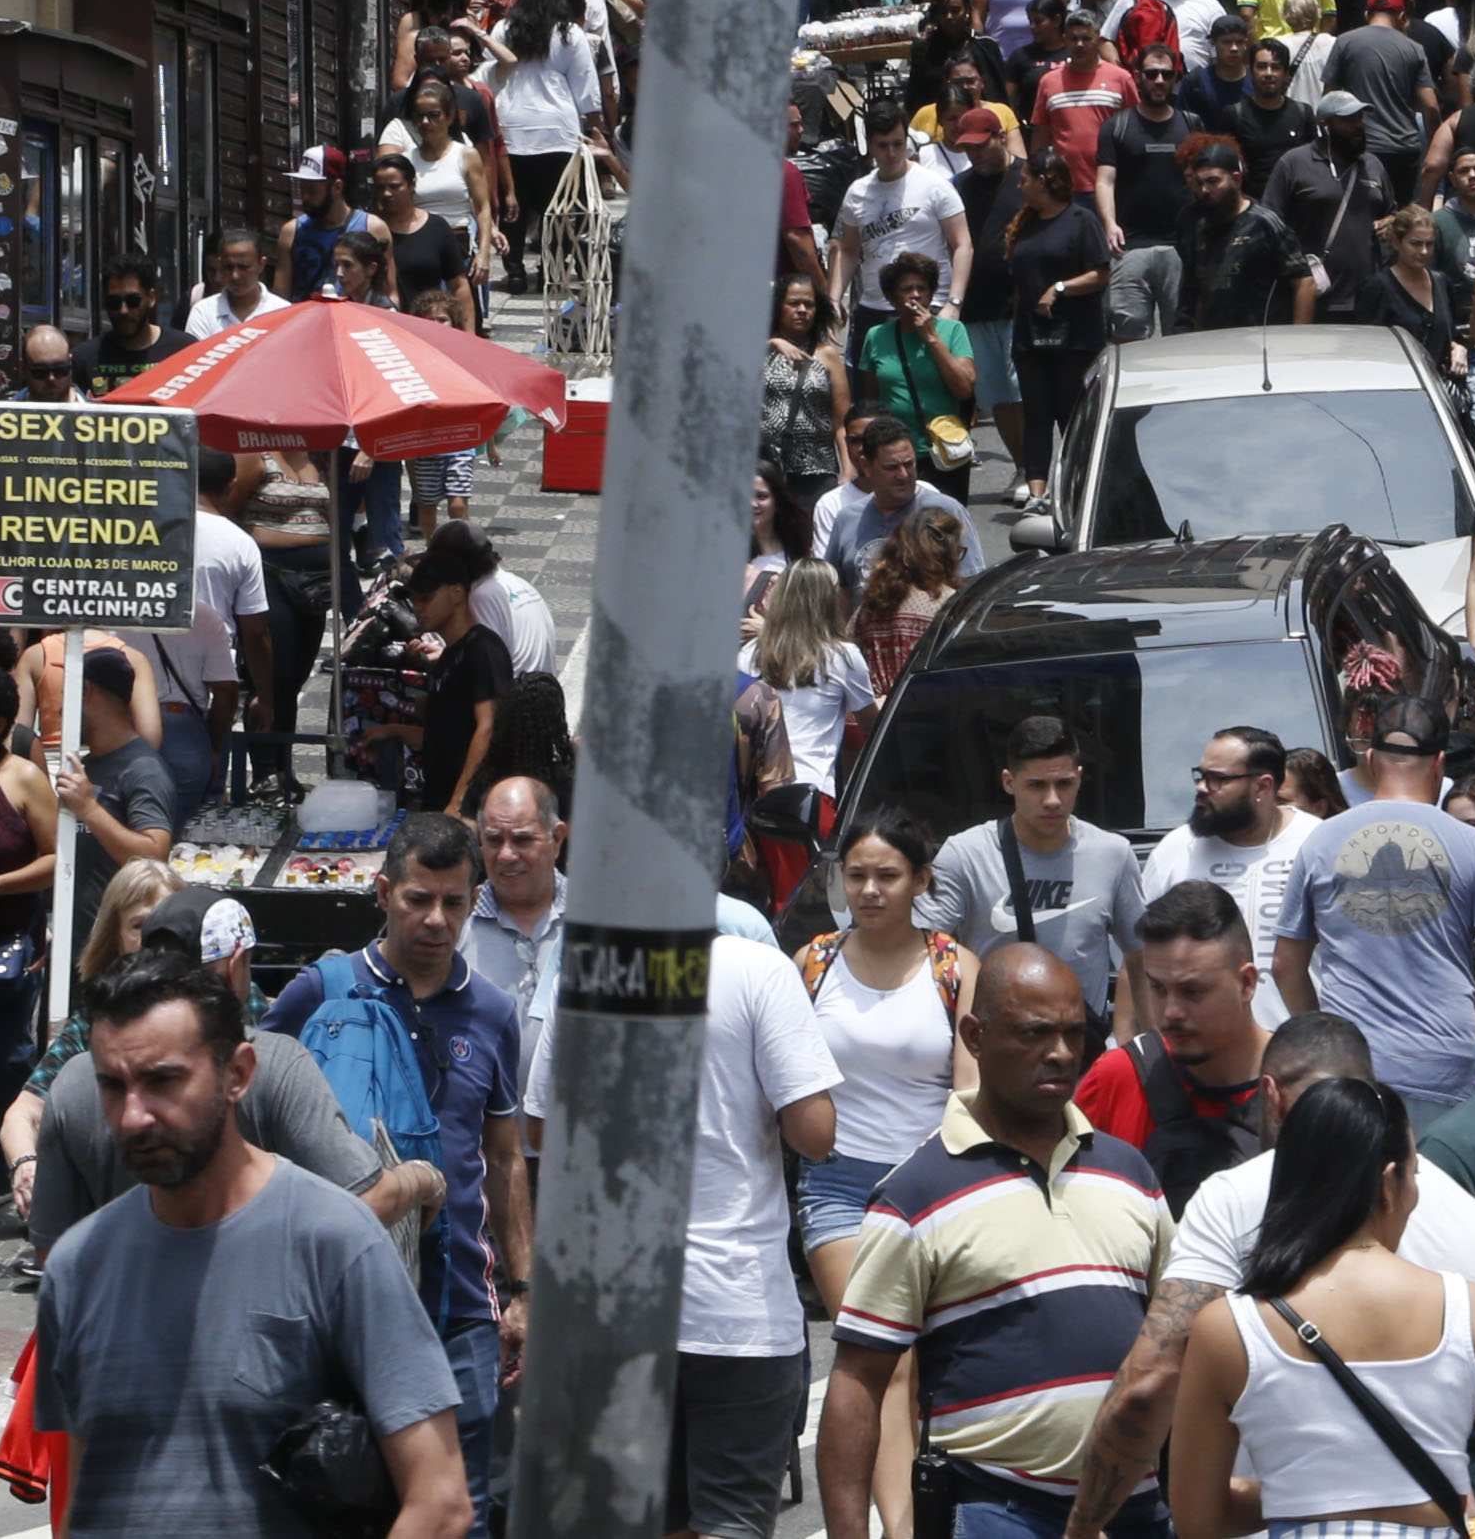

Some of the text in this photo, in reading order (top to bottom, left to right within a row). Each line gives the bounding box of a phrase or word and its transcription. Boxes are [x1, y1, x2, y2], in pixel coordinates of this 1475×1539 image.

[148, 327, 268, 400] BRAHMA
[349, 327, 440, 405] BRAHMA
[74, 415, 169, 445] SHOP
[237, 431, 308, 449] BRAHMA
[5, 476, 158, 506] LINGERIE
[0, 515, 160, 546] REVENDA
[39, 557, 69, 569] LOJA
[74, 558, 91, 569] DA
[95, 558, 109, 570] 25
[113, 559, 128, 570] DE
[132, 560, 178, 573] MARÇO
[32, 578, 177, 599] CENTRAL DAS
[42, 598, 166, 618] CALCINHAS
